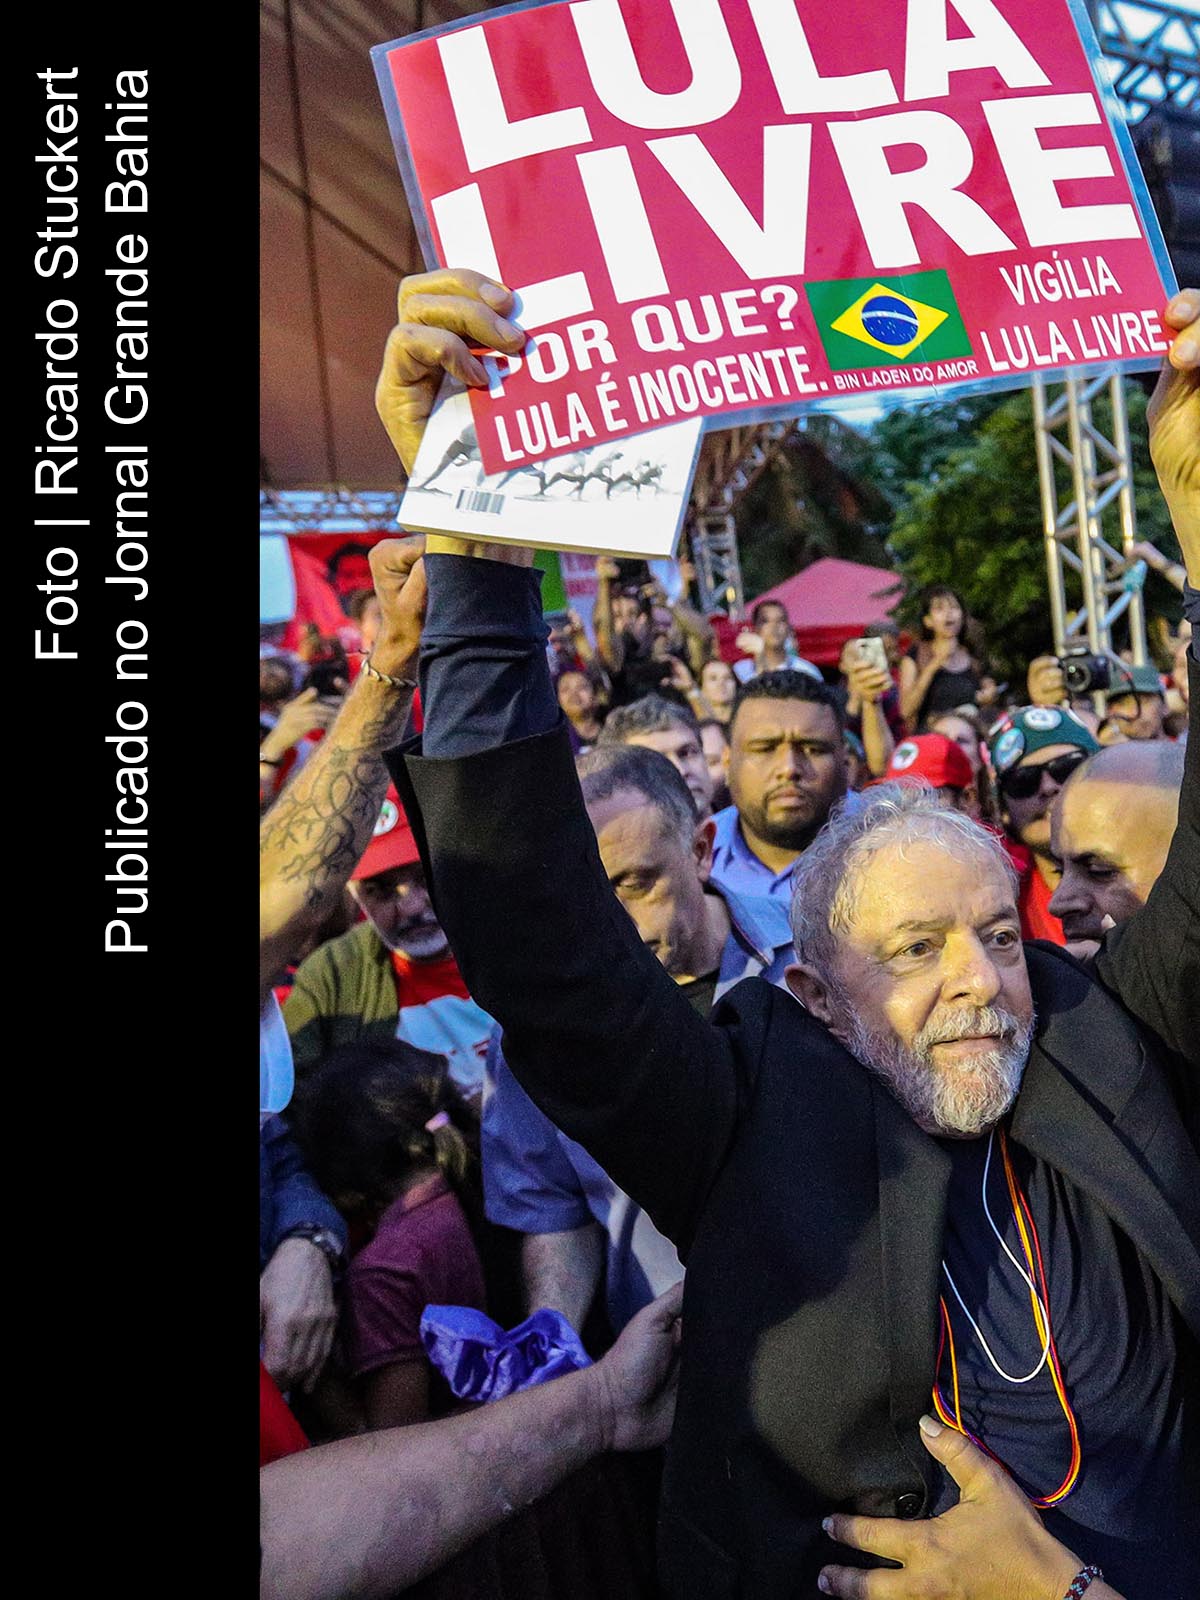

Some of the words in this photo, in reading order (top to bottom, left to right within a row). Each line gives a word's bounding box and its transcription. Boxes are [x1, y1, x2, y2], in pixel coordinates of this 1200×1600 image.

[435, 0, 1053, 174] LULA
[432, 92, 1143, 332] LIVRE
[998, 250, 1123, 306] VIGÍLIA
[480, 319, 618, 399] POR
[630, 284, 799, 353] QUE?
[833, 373, 861, 390] BIN
[861, 368, 911, 387] LADEN
[912, 366, 934, 383] DO
[936, 360, 979, 381] AMOR
[980, 321, 1076, 372] LULA
[494, 392, 597, 463] LULA
[595, 371, 629, 432] É
[627, 345, 829, 423] INOCENTE.
